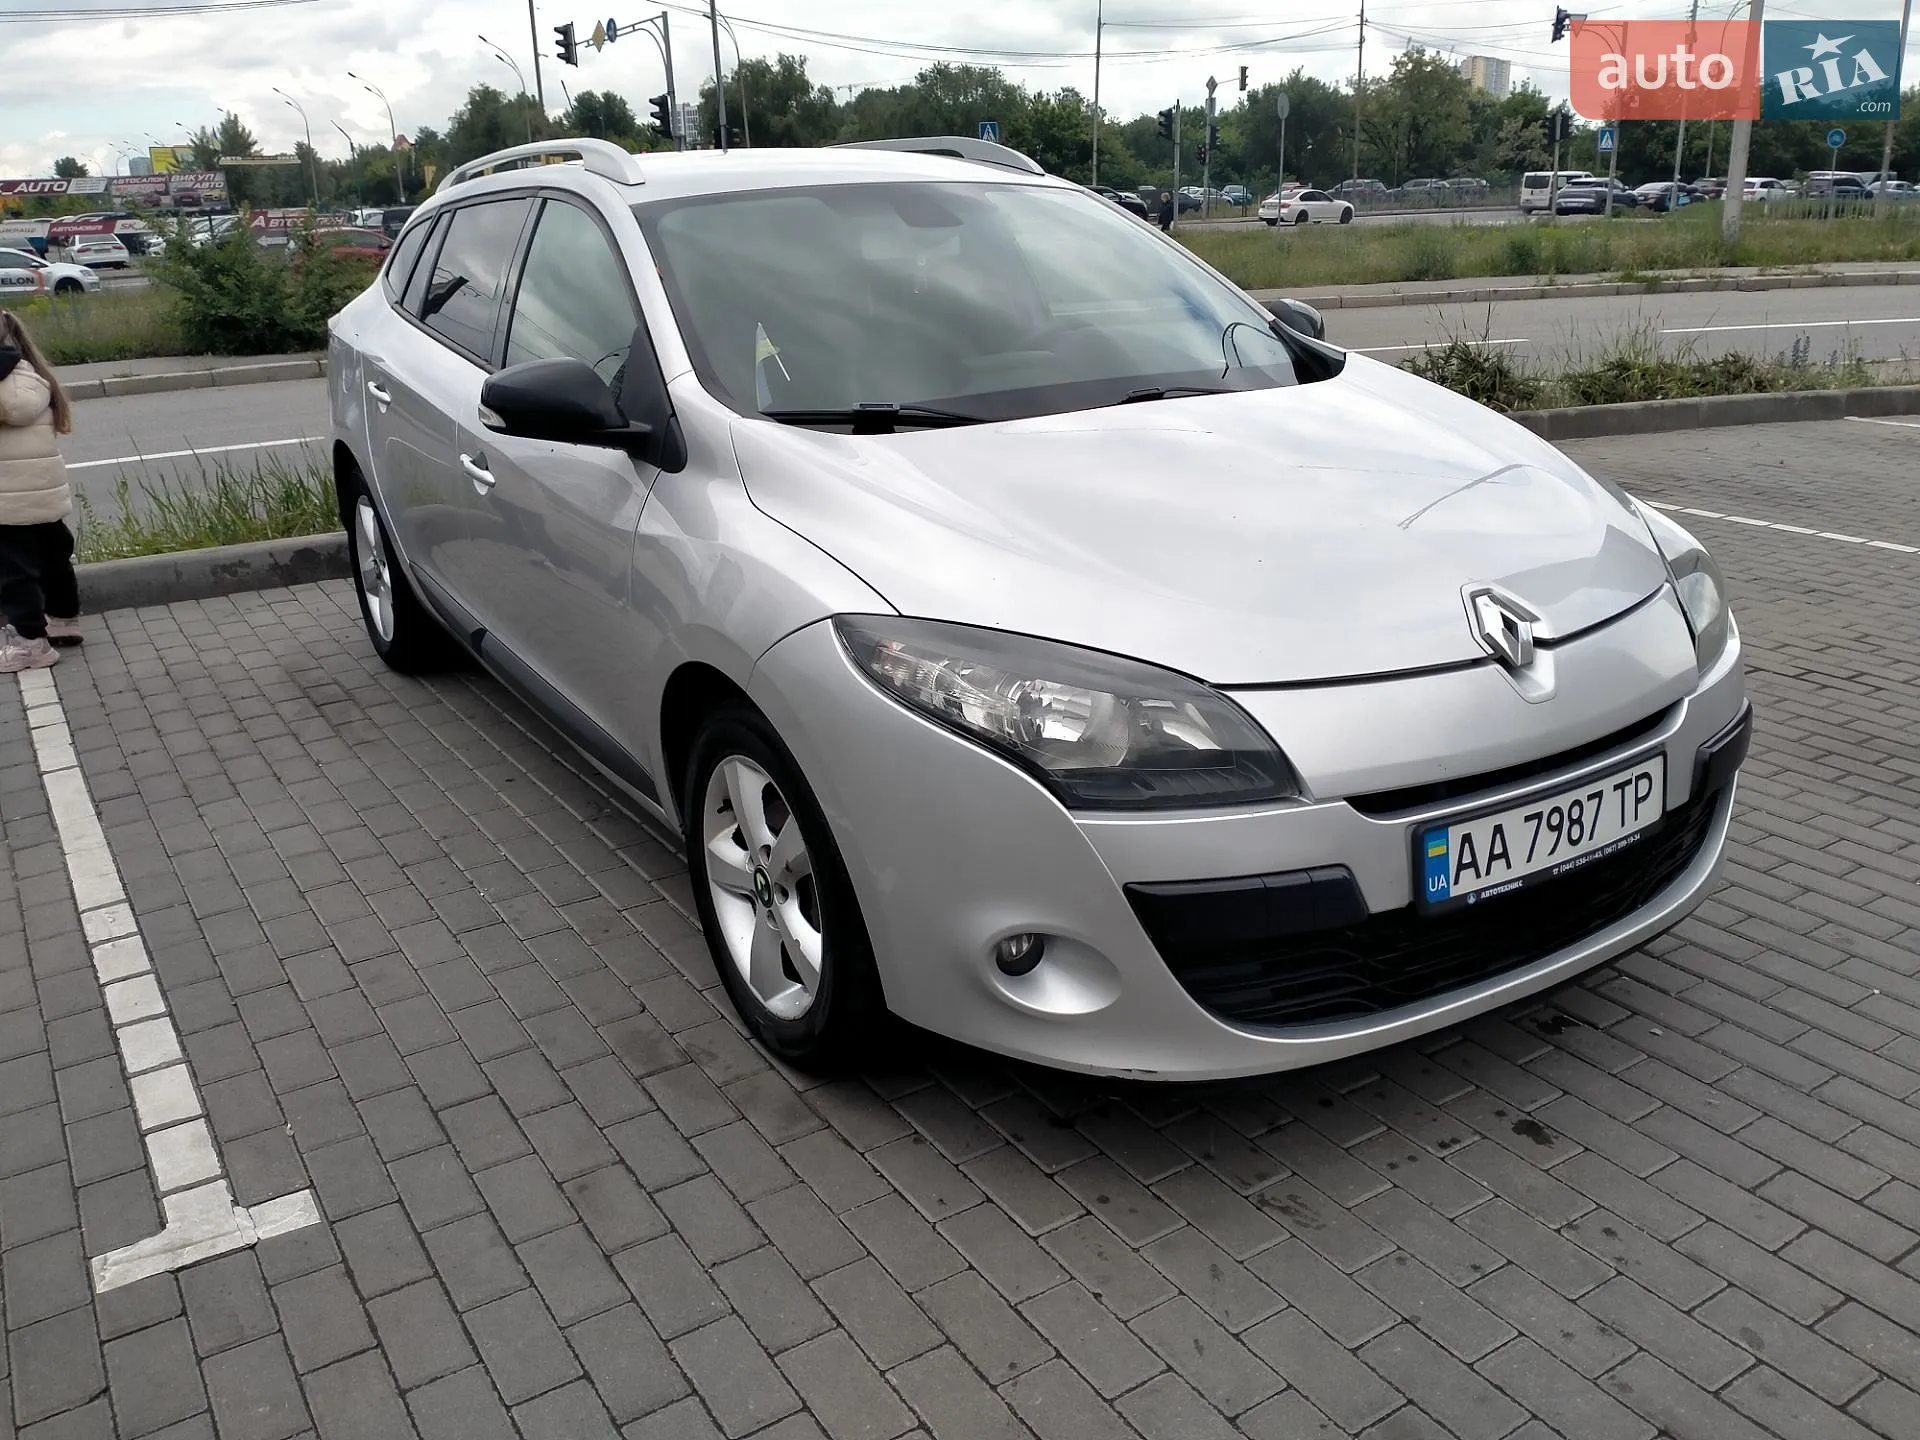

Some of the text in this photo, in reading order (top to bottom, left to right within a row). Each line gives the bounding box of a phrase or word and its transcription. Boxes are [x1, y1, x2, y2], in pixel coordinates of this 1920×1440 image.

[171, 173, 214, 182] ВИКУП
[193, 181, 224, 189] АВТО
[1453, 771, 1653, 886] AA 7987 TP
[1429, 873, 1448, 892] UA
